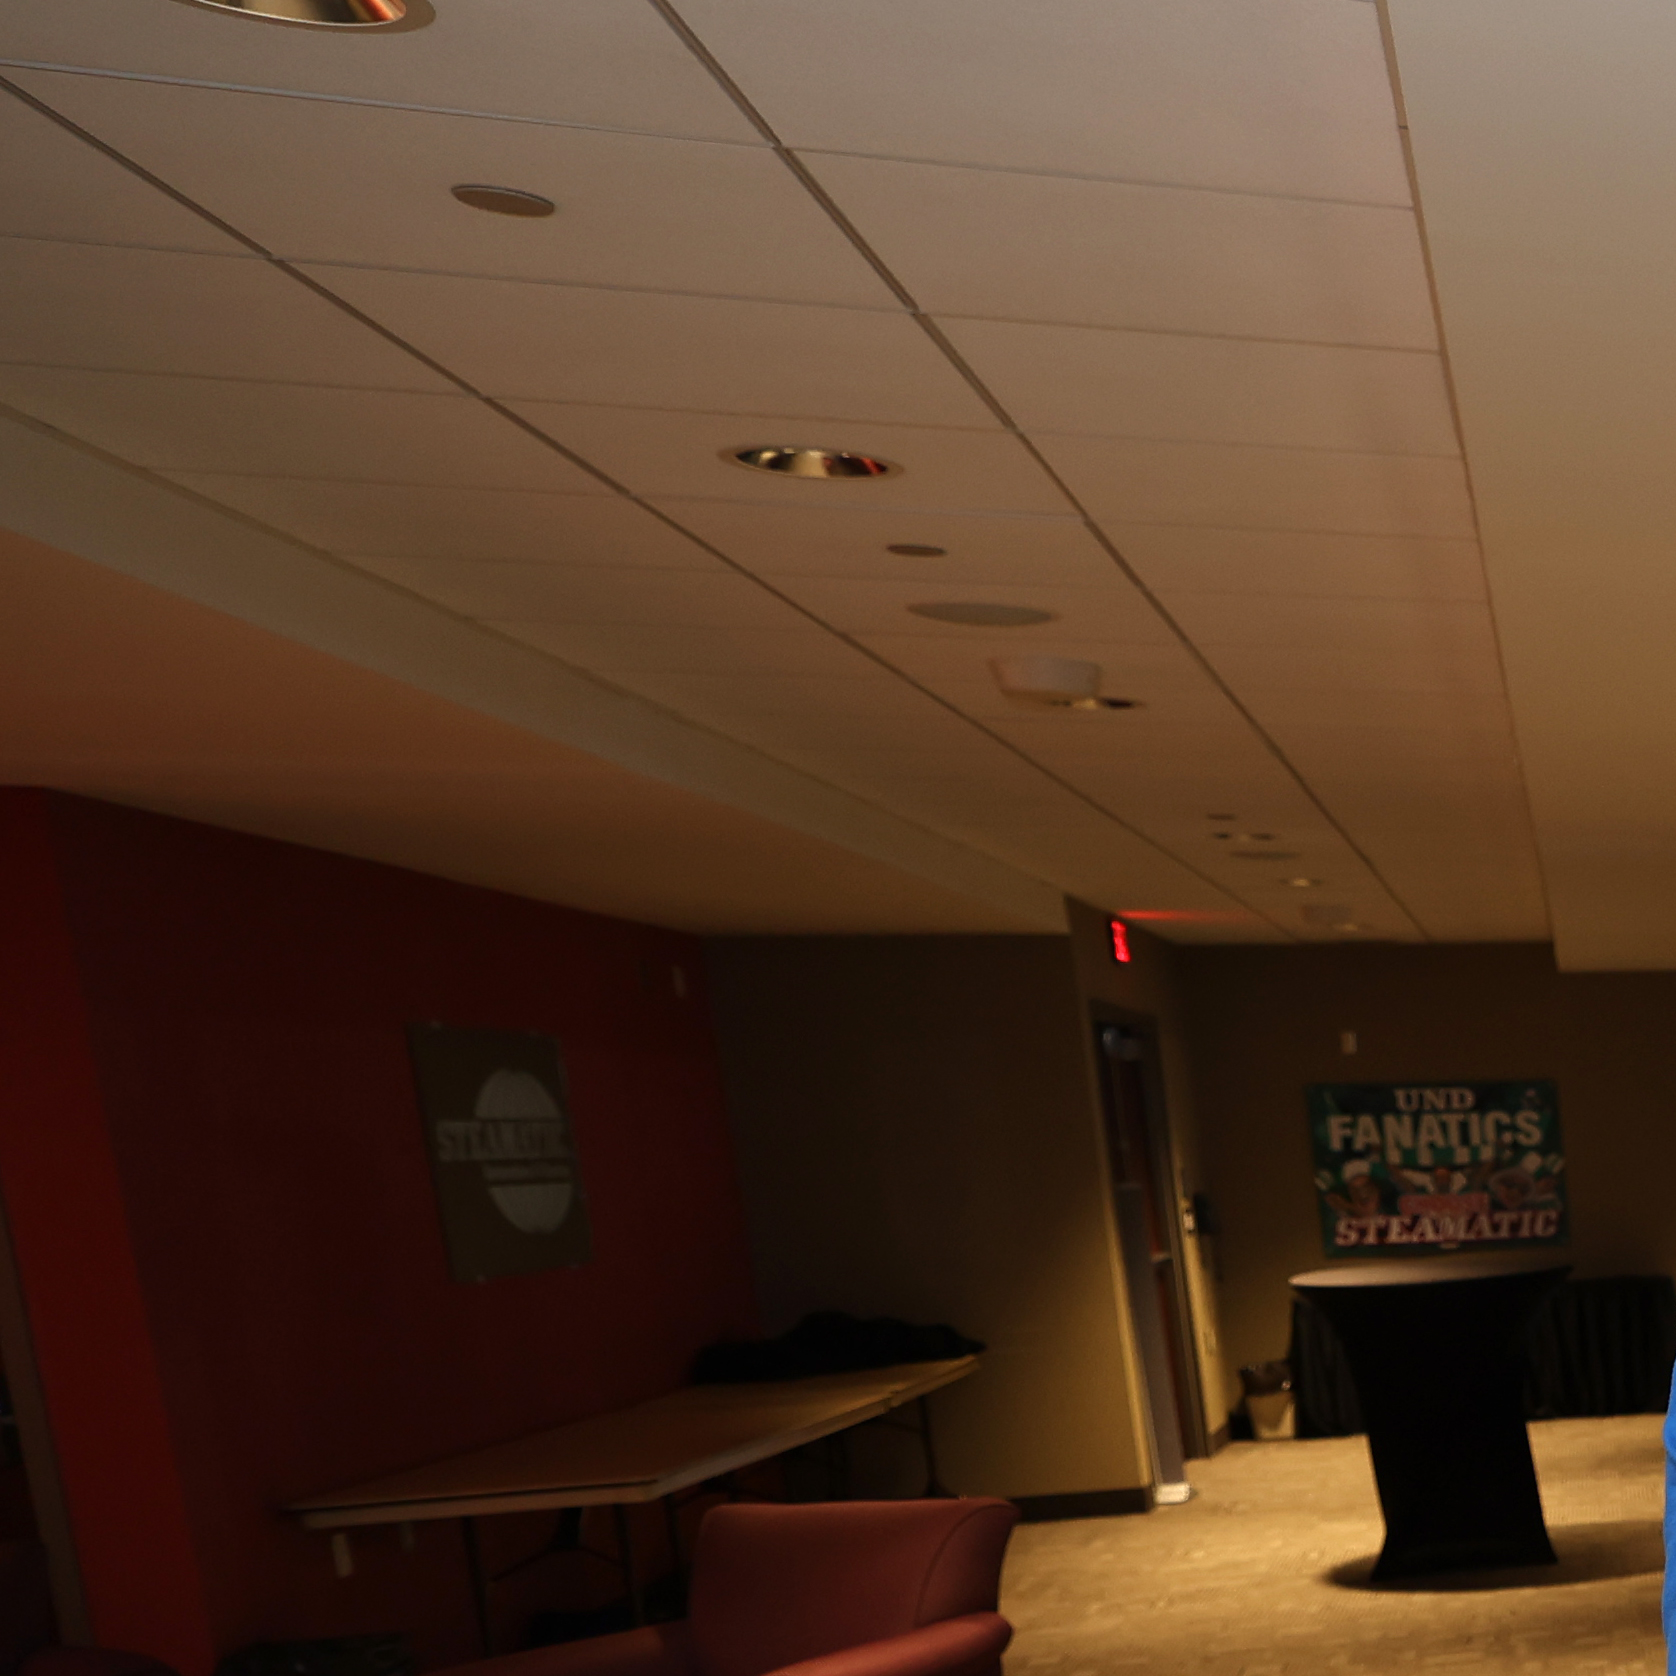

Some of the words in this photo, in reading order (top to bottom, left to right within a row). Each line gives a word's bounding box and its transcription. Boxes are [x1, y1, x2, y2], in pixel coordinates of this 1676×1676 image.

[1396, 1088, 1475, 1109] UND
[1328, 1111, 1541, 1165] FANATICS
[1334, 1209, 1558, 1247] STEAMATIC
